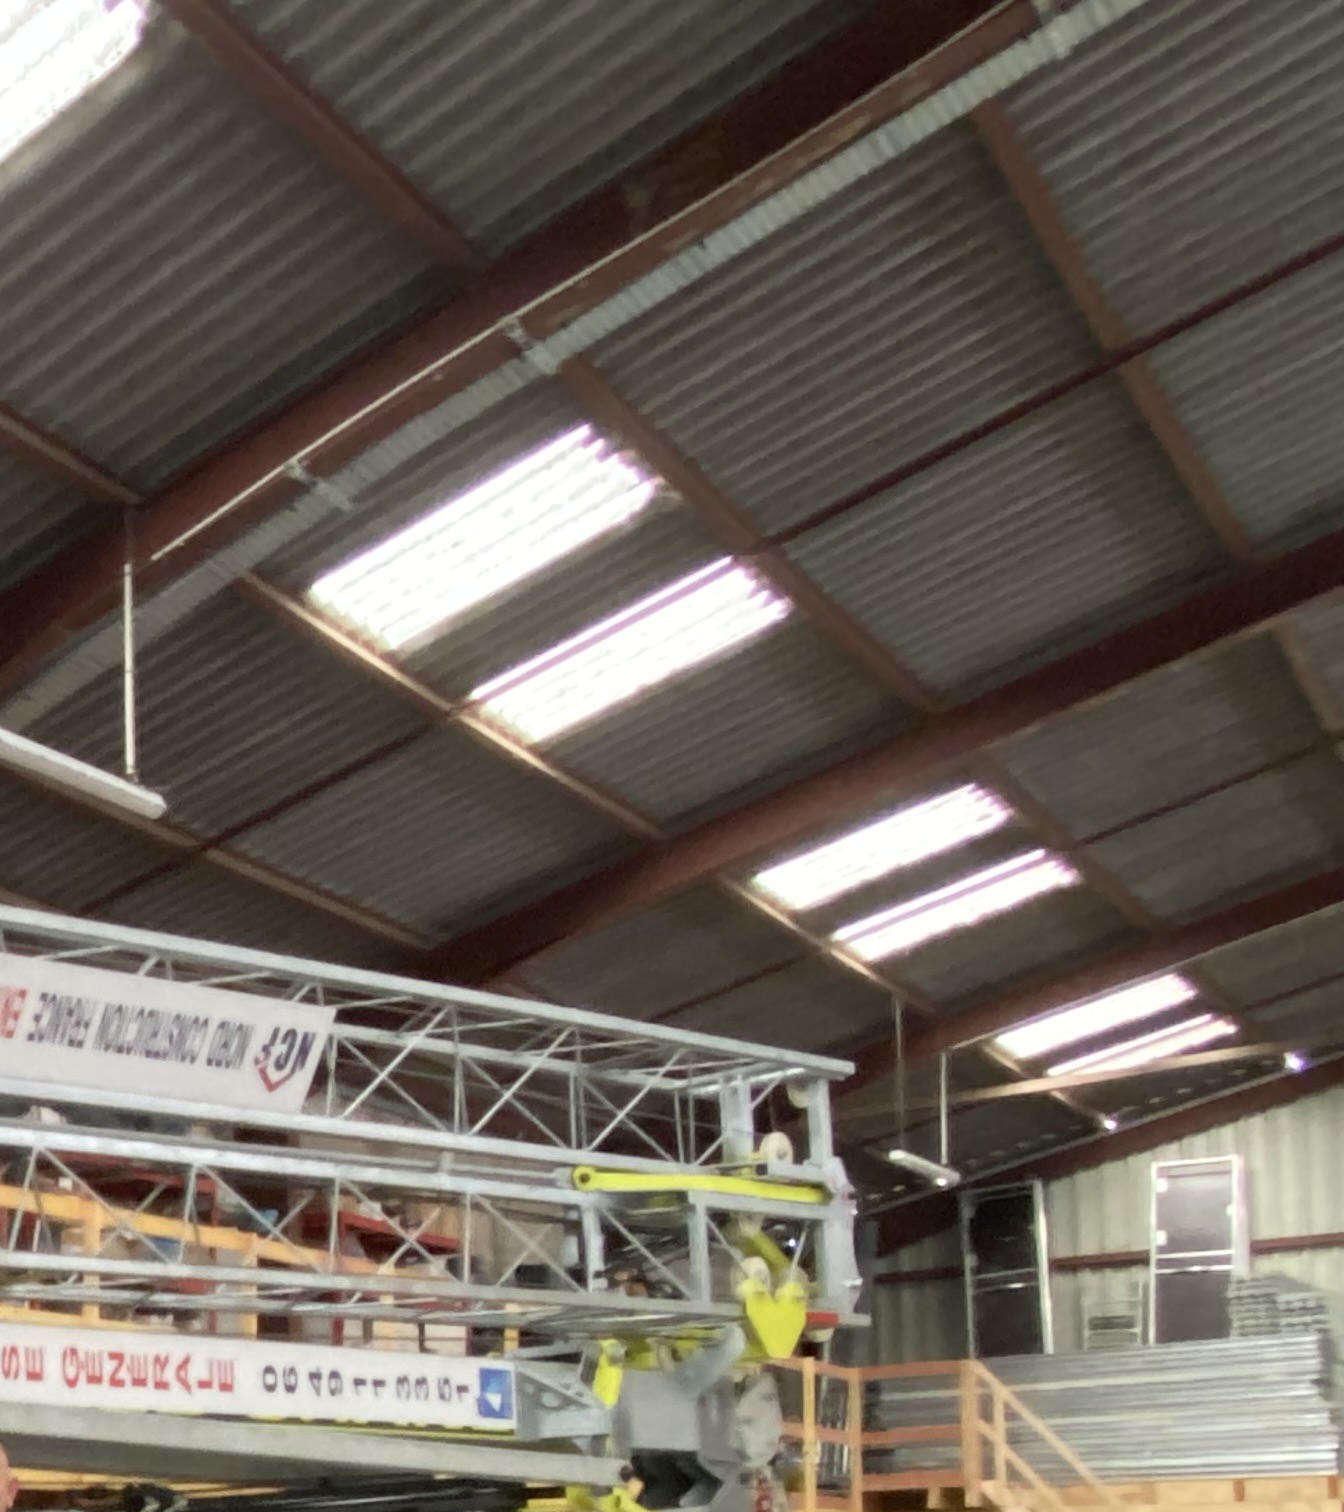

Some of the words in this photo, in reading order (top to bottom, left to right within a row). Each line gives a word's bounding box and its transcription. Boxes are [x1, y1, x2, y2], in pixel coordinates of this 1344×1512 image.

[27, 992, 99, 1048] FRANCE
[93, 1003, 209, 1064] CONSTRUCTION
[207, 1021, 255, 1069] NORD
[262, 1365, 297, 1394] 06
[396, 1374, 429, 1402] 33
